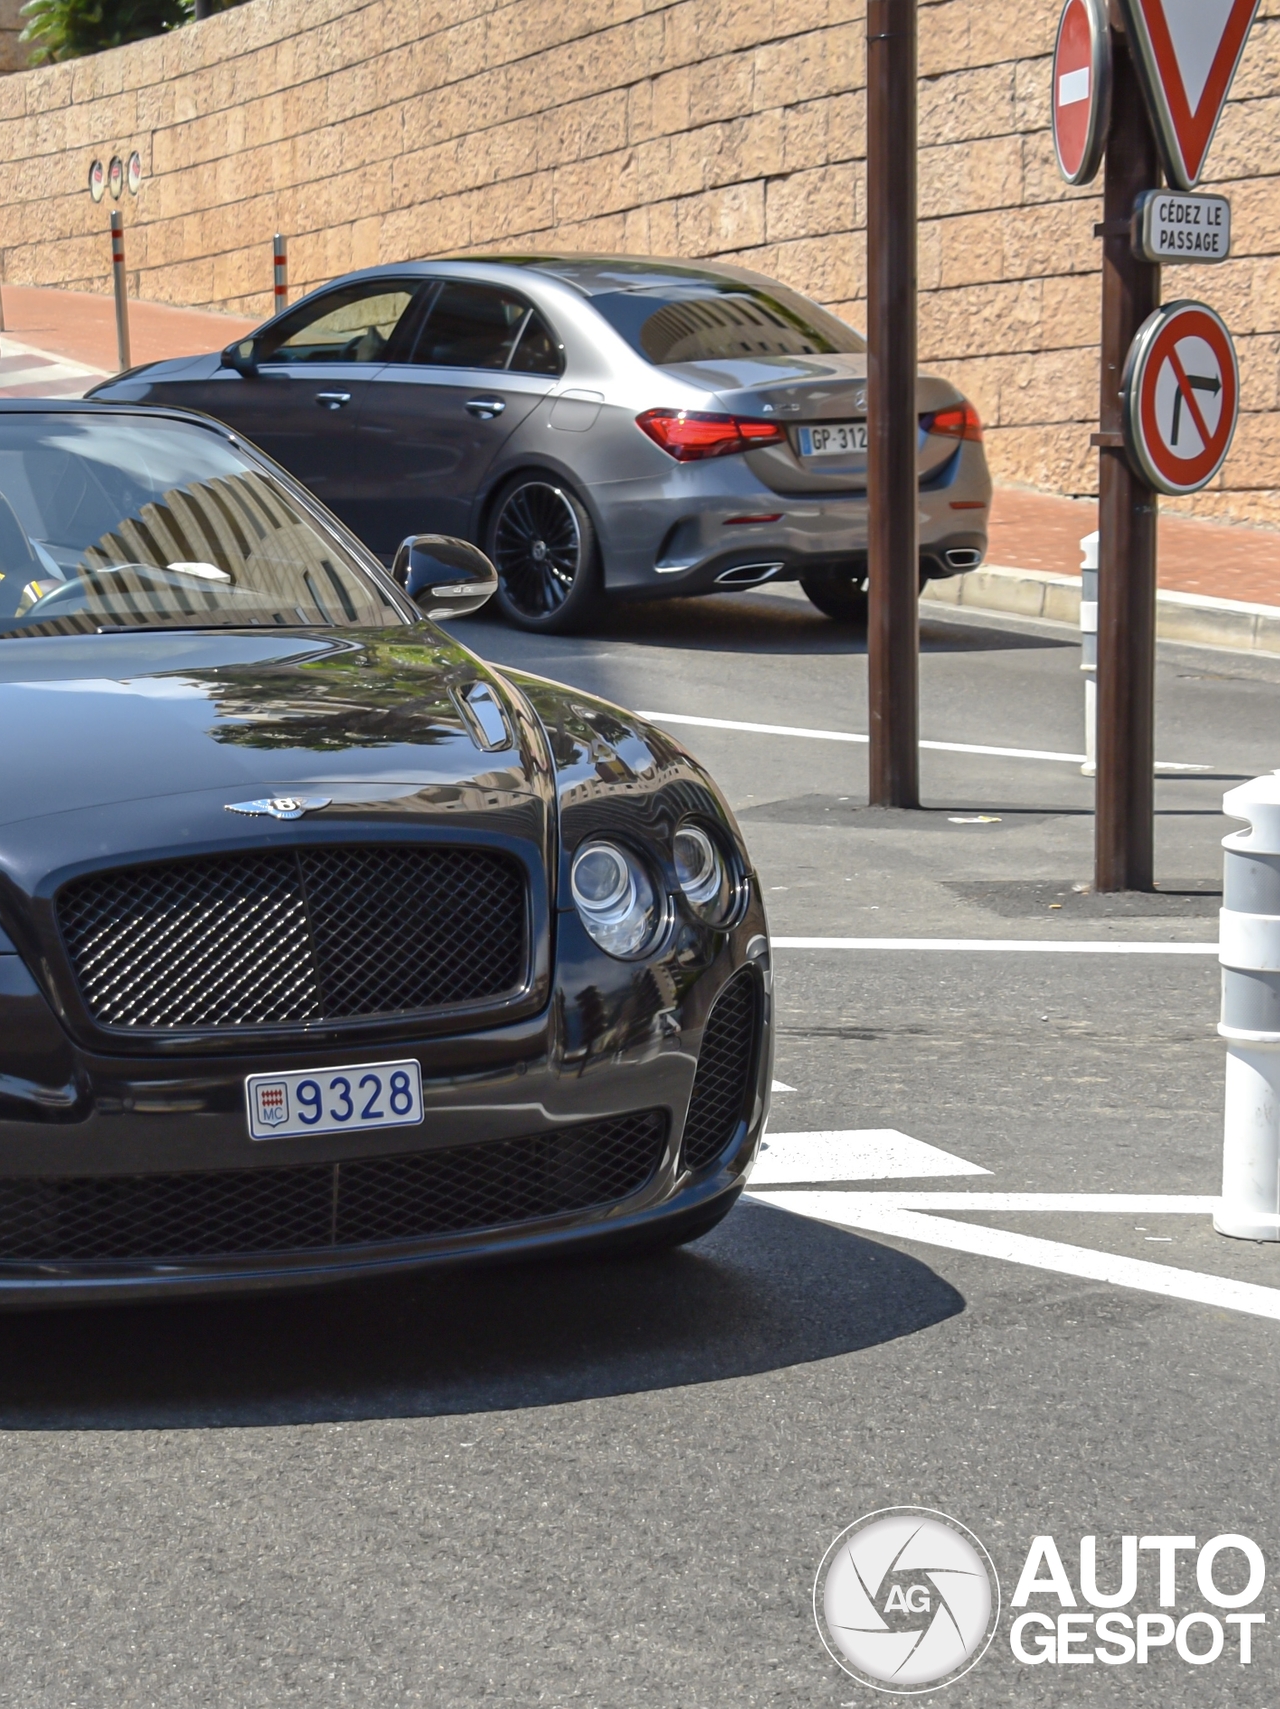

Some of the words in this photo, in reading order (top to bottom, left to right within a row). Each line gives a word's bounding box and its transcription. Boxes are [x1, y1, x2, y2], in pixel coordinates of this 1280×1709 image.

[1160, 199, 1200, 224] CÉDEZ
[1207, 206, 1222, 226] LE
[1160, 230, 1219, 252] PASSAGE
[296, 1071, 414, 1125] 9328
[263, 1106, 283, 1120] MC
